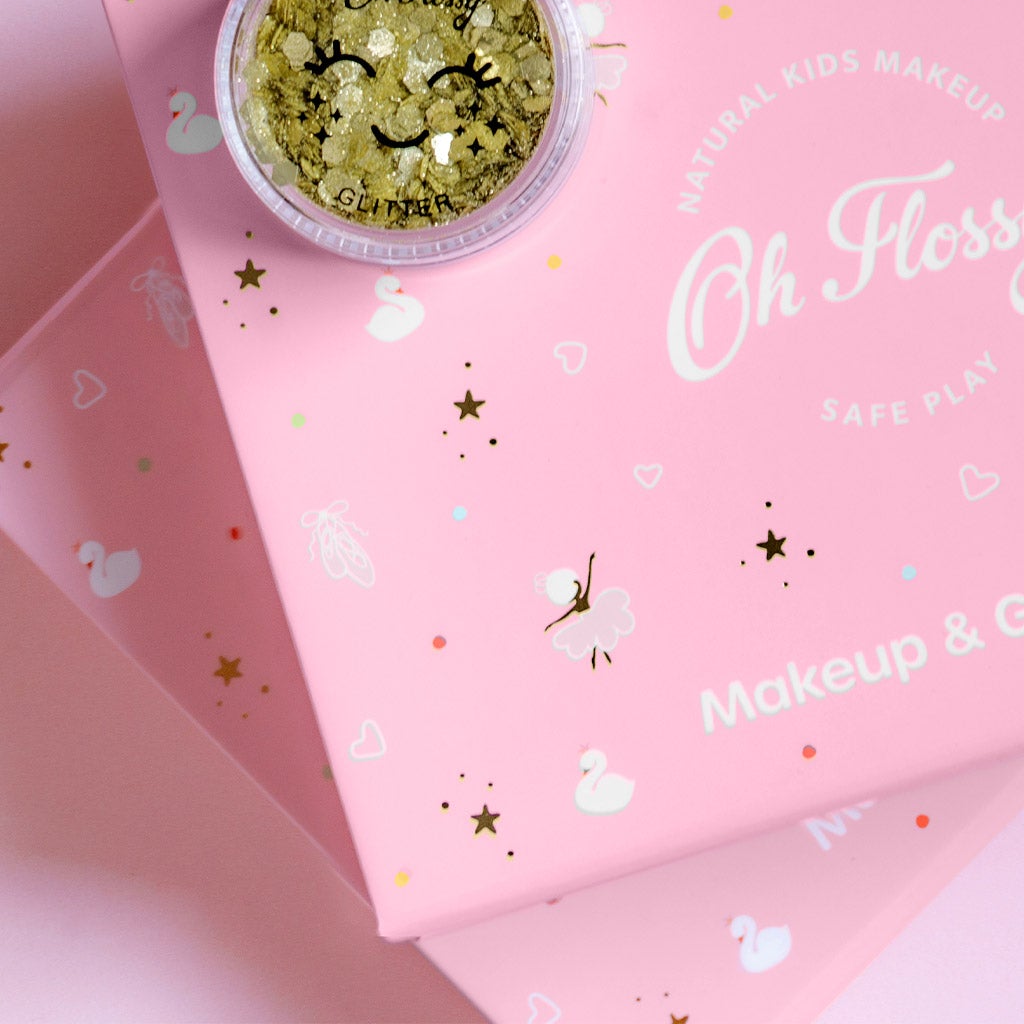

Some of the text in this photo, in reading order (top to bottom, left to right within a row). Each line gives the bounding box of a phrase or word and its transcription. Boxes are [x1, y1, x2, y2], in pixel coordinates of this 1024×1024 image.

[676, 48, 1007, 215] NATURAL KIDS MAKEUP
[337, 187, 455, 218] GLITTER
[666, 225, 806, 382] Oh
[820, 349, 999, 428] SAFE PLAY
[699, 632, 928, 736] Makeup
[944, 611, 986, 657] &
